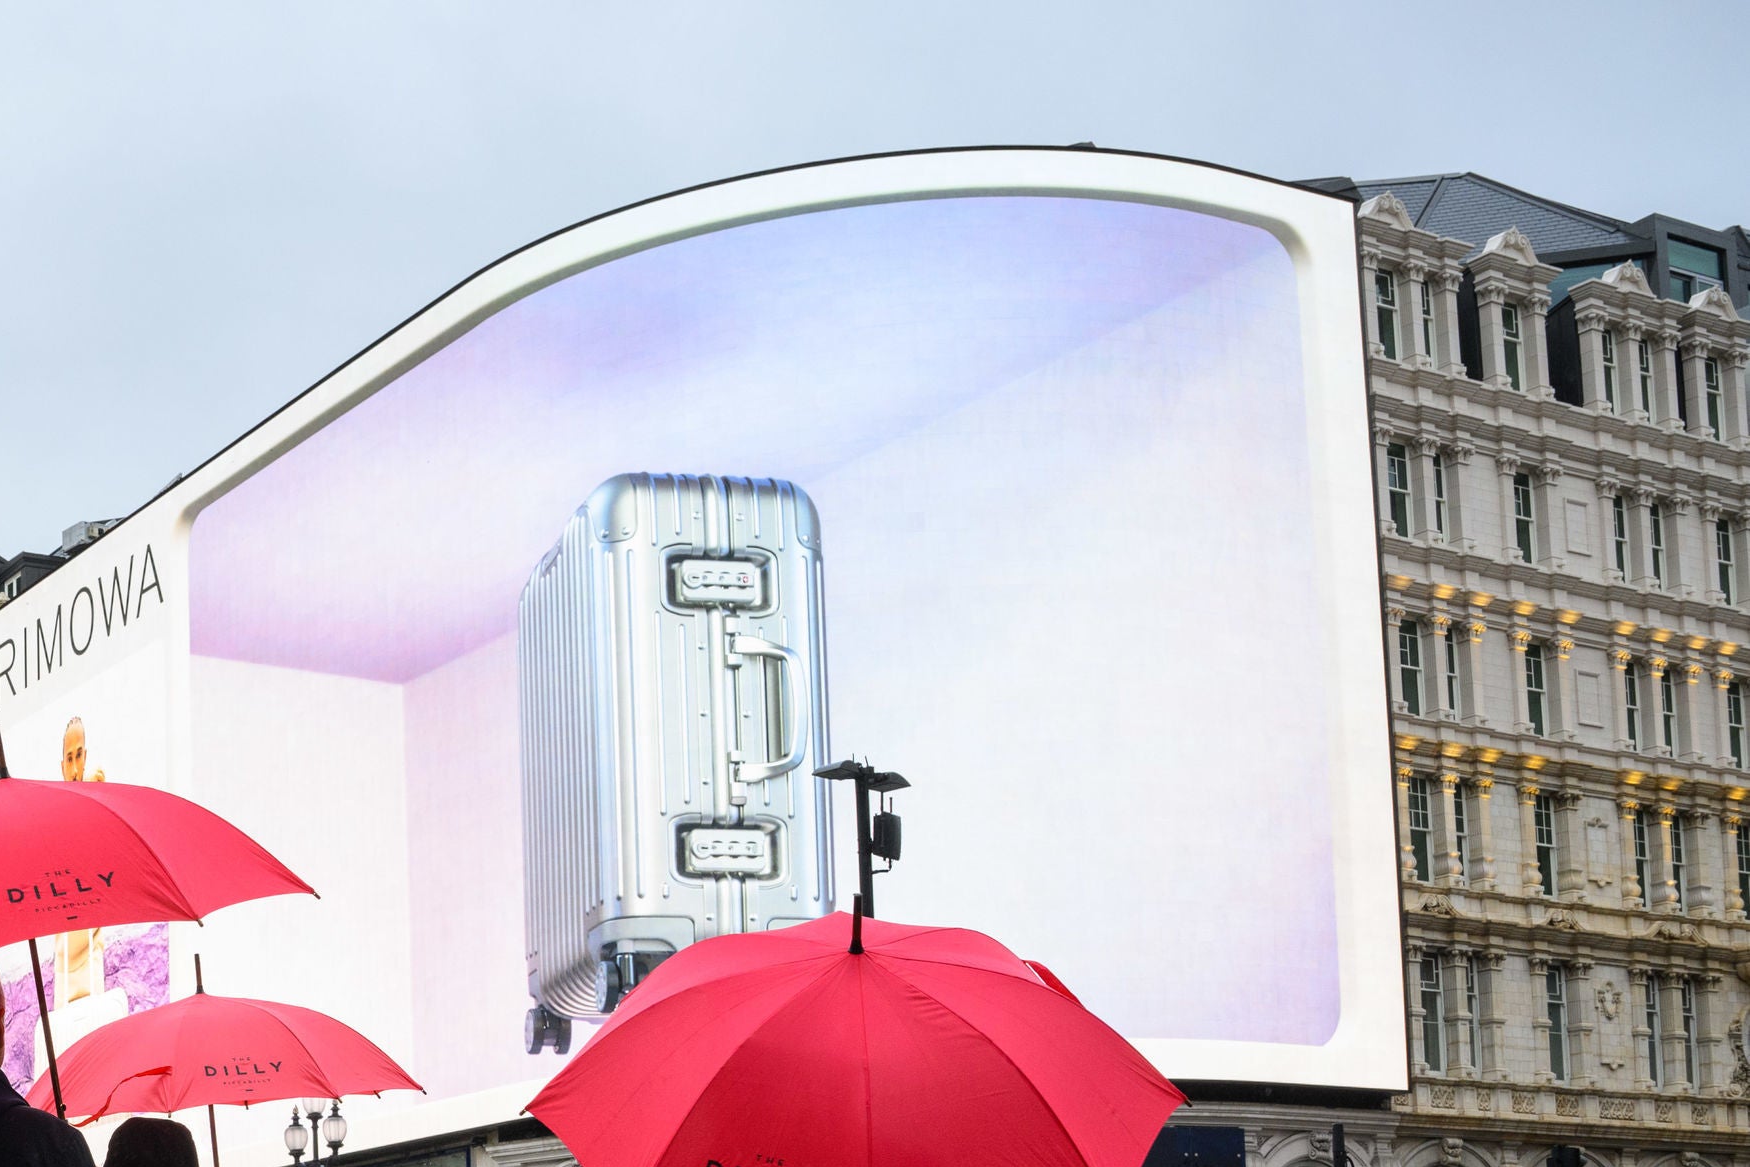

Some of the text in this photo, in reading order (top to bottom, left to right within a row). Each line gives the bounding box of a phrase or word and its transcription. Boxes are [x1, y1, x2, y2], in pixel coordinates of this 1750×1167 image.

[44, 868, 71, 878] THE
[6, 871, 115, 904] DILLY
[34, 897, 102, 913] PICCADILLY
[204, 1061, 282, 1077] DILLY
[756, 1154, 786, 1167] THE
